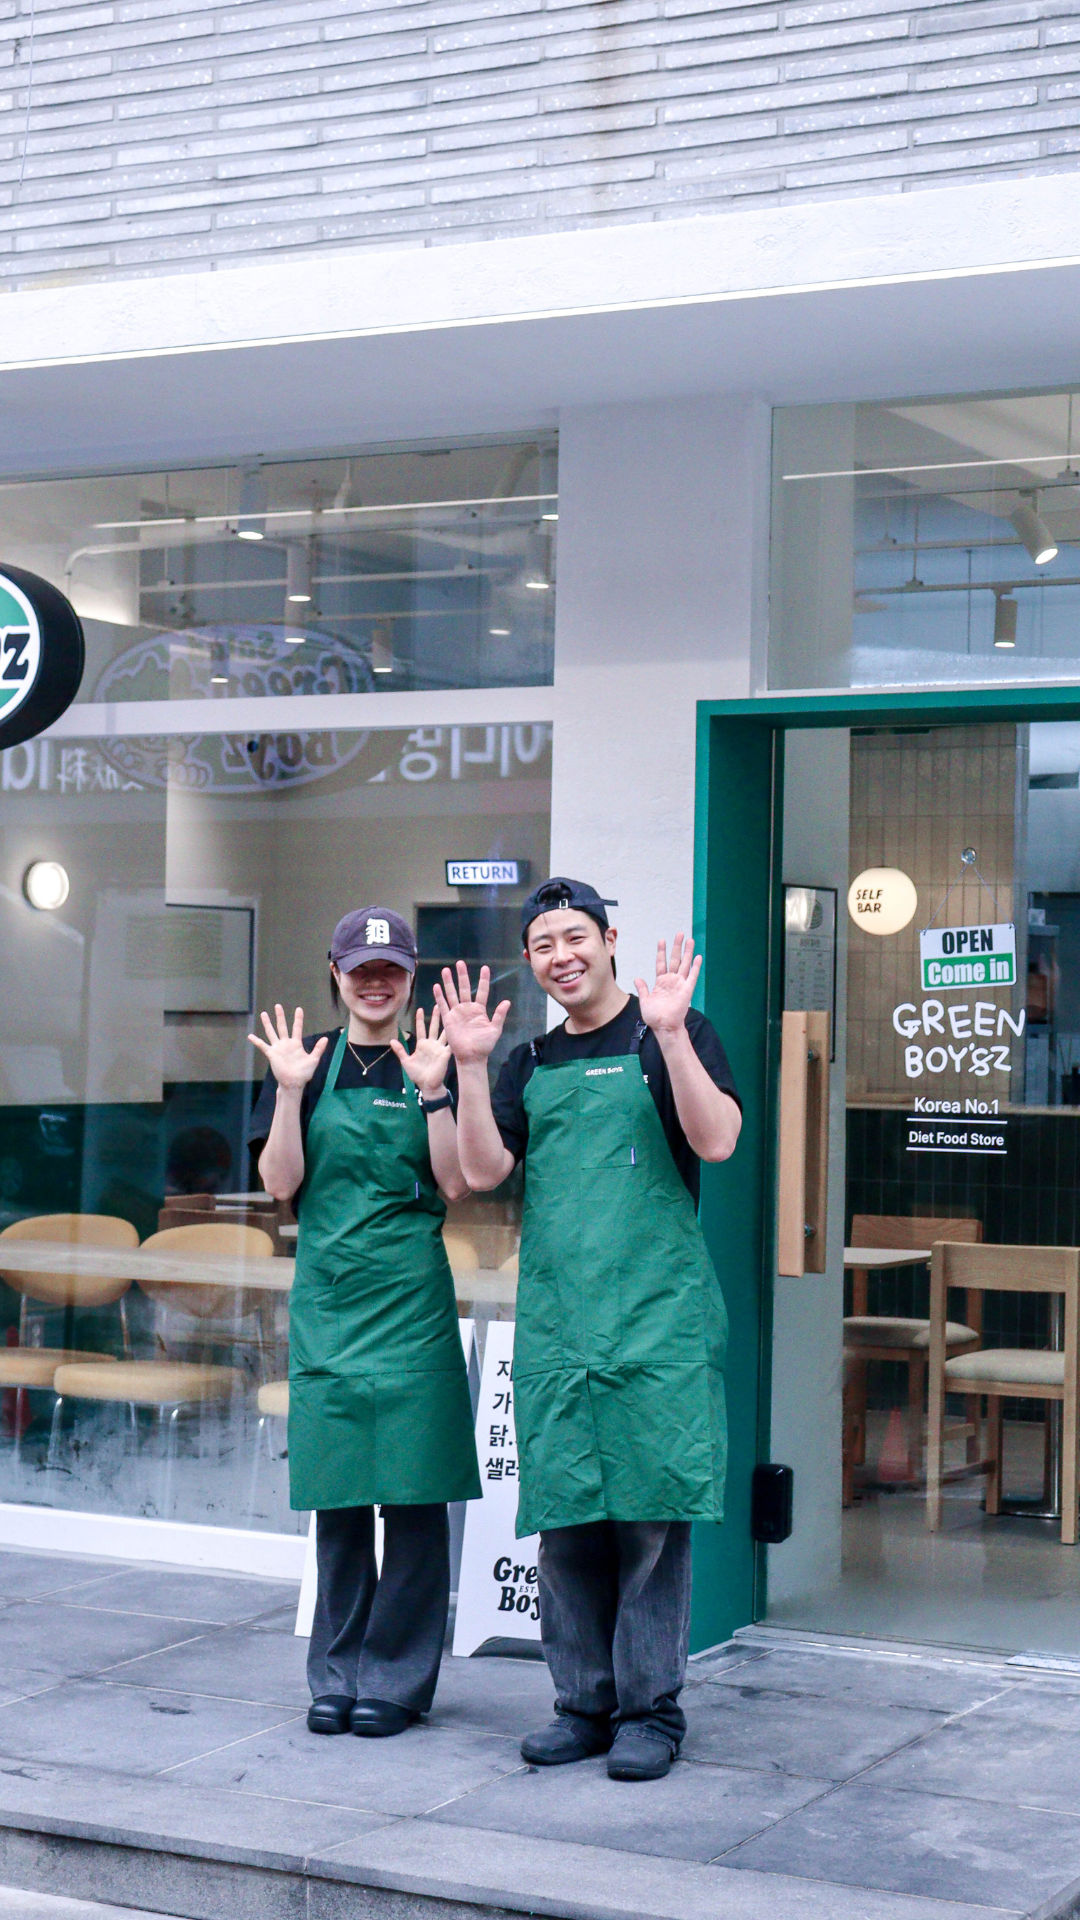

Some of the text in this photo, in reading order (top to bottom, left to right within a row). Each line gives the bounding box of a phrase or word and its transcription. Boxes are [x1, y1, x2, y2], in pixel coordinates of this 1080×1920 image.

[451, 863, 514, 881] RETURN
[856, 889, 884, 900] SELF
[857, 902, 881, 913] BAR
[942, 929, 993, 954] OPEN
[928, 958, 1010, 984] Come in
[893, 999, 1026, 1039] GREEN
[914, 1097, 999, 1115] Korea No.1
[908, 1131, 1004, 1146] Diet Food Store
